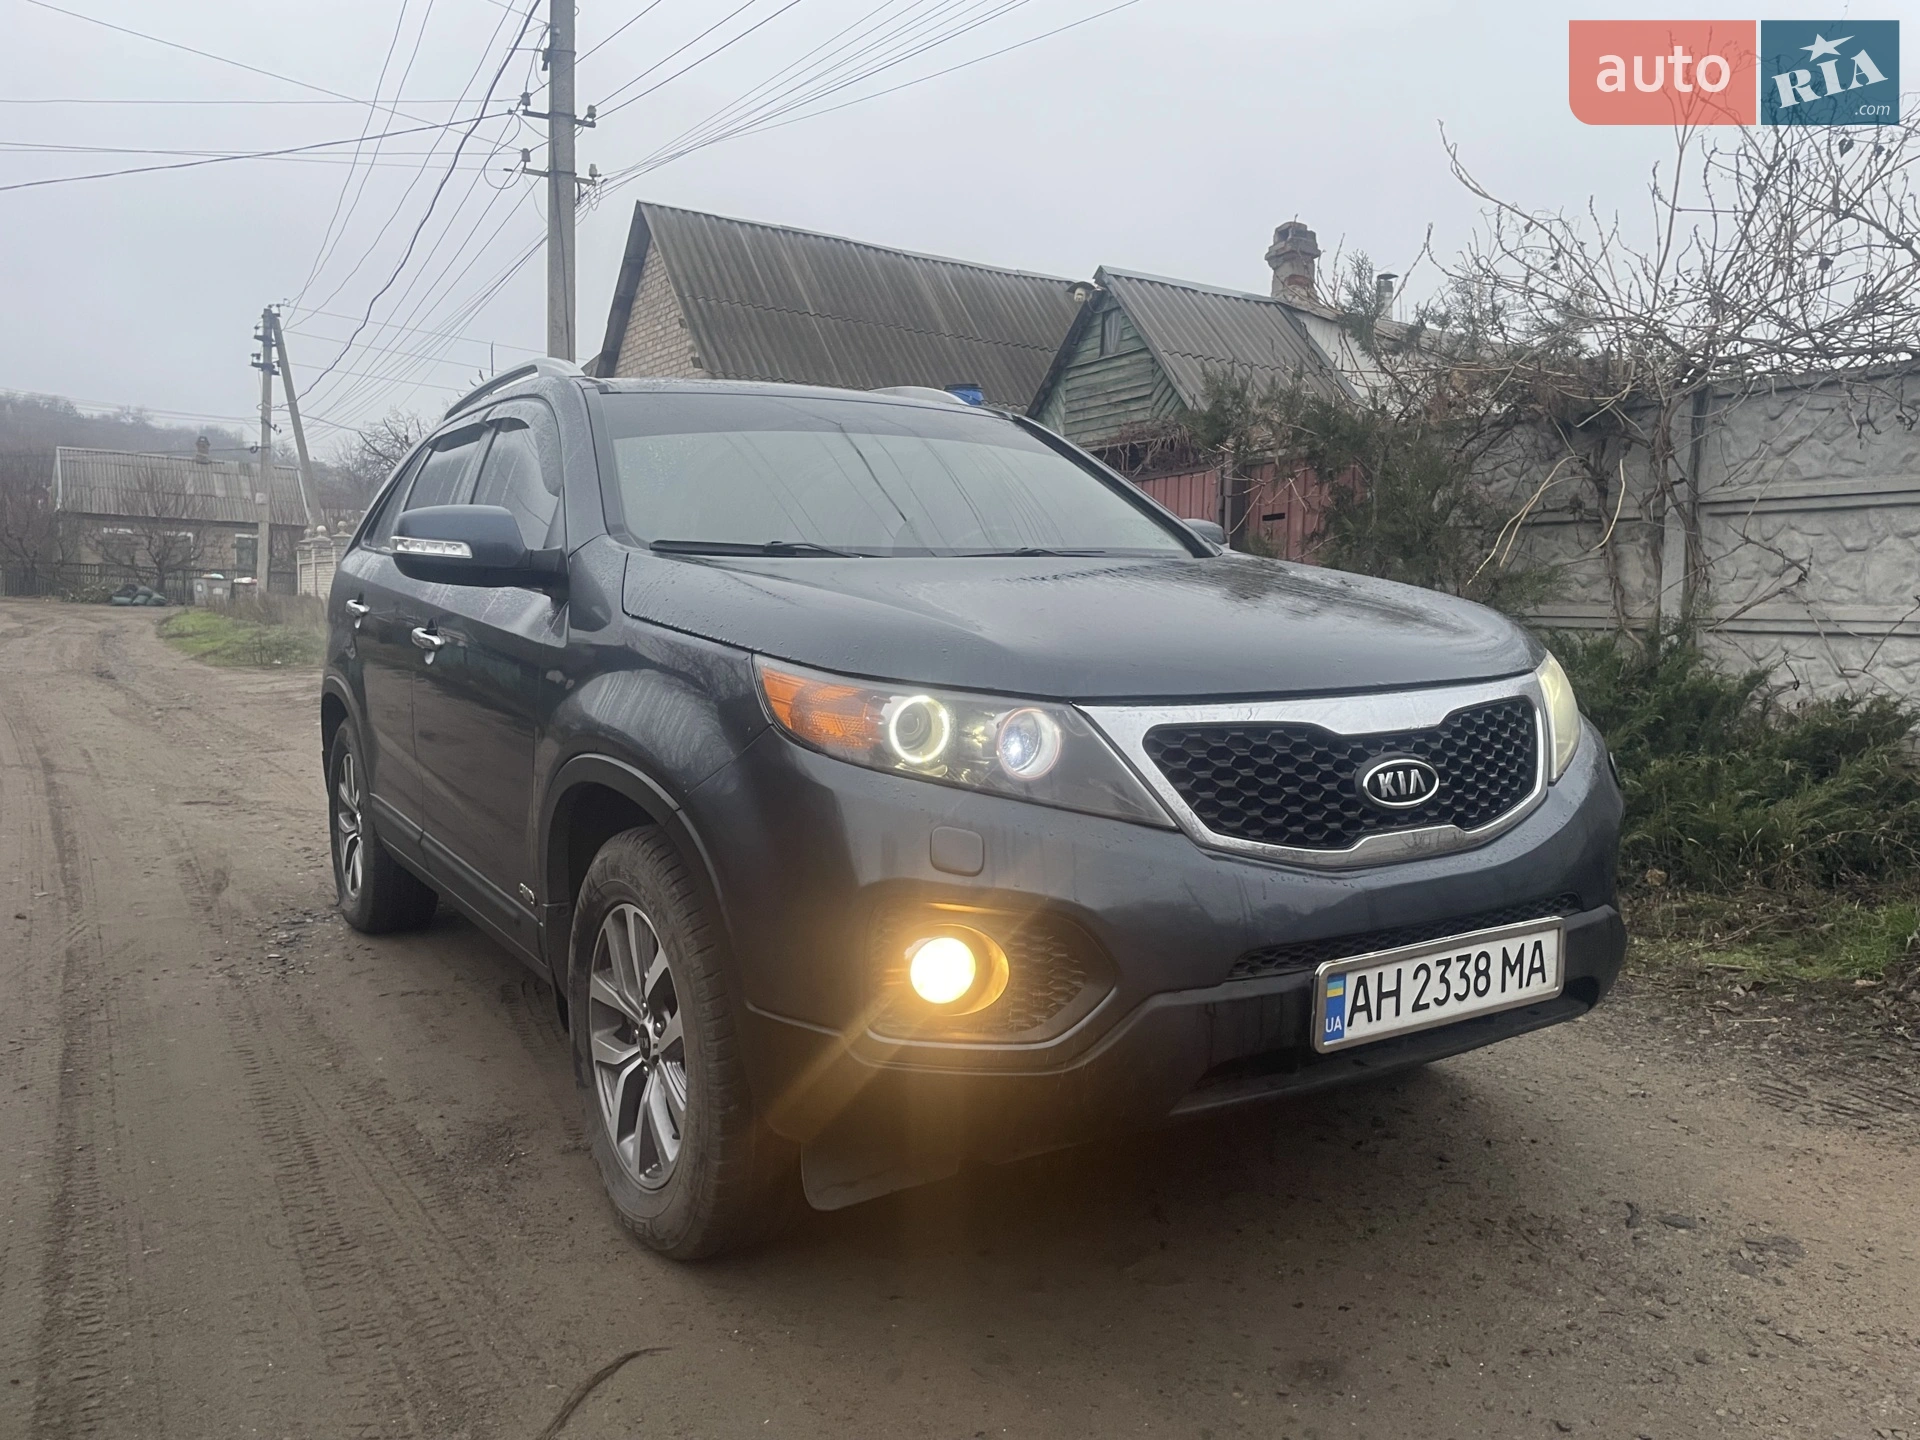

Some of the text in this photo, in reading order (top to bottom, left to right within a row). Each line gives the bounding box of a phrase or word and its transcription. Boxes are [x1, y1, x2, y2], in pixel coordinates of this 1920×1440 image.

[1377, 769, 1427, 798] KIA
[1347, 940, 1546, 1027] AH 2338 MA
[1325, 1017, 1342, 1033] UA
